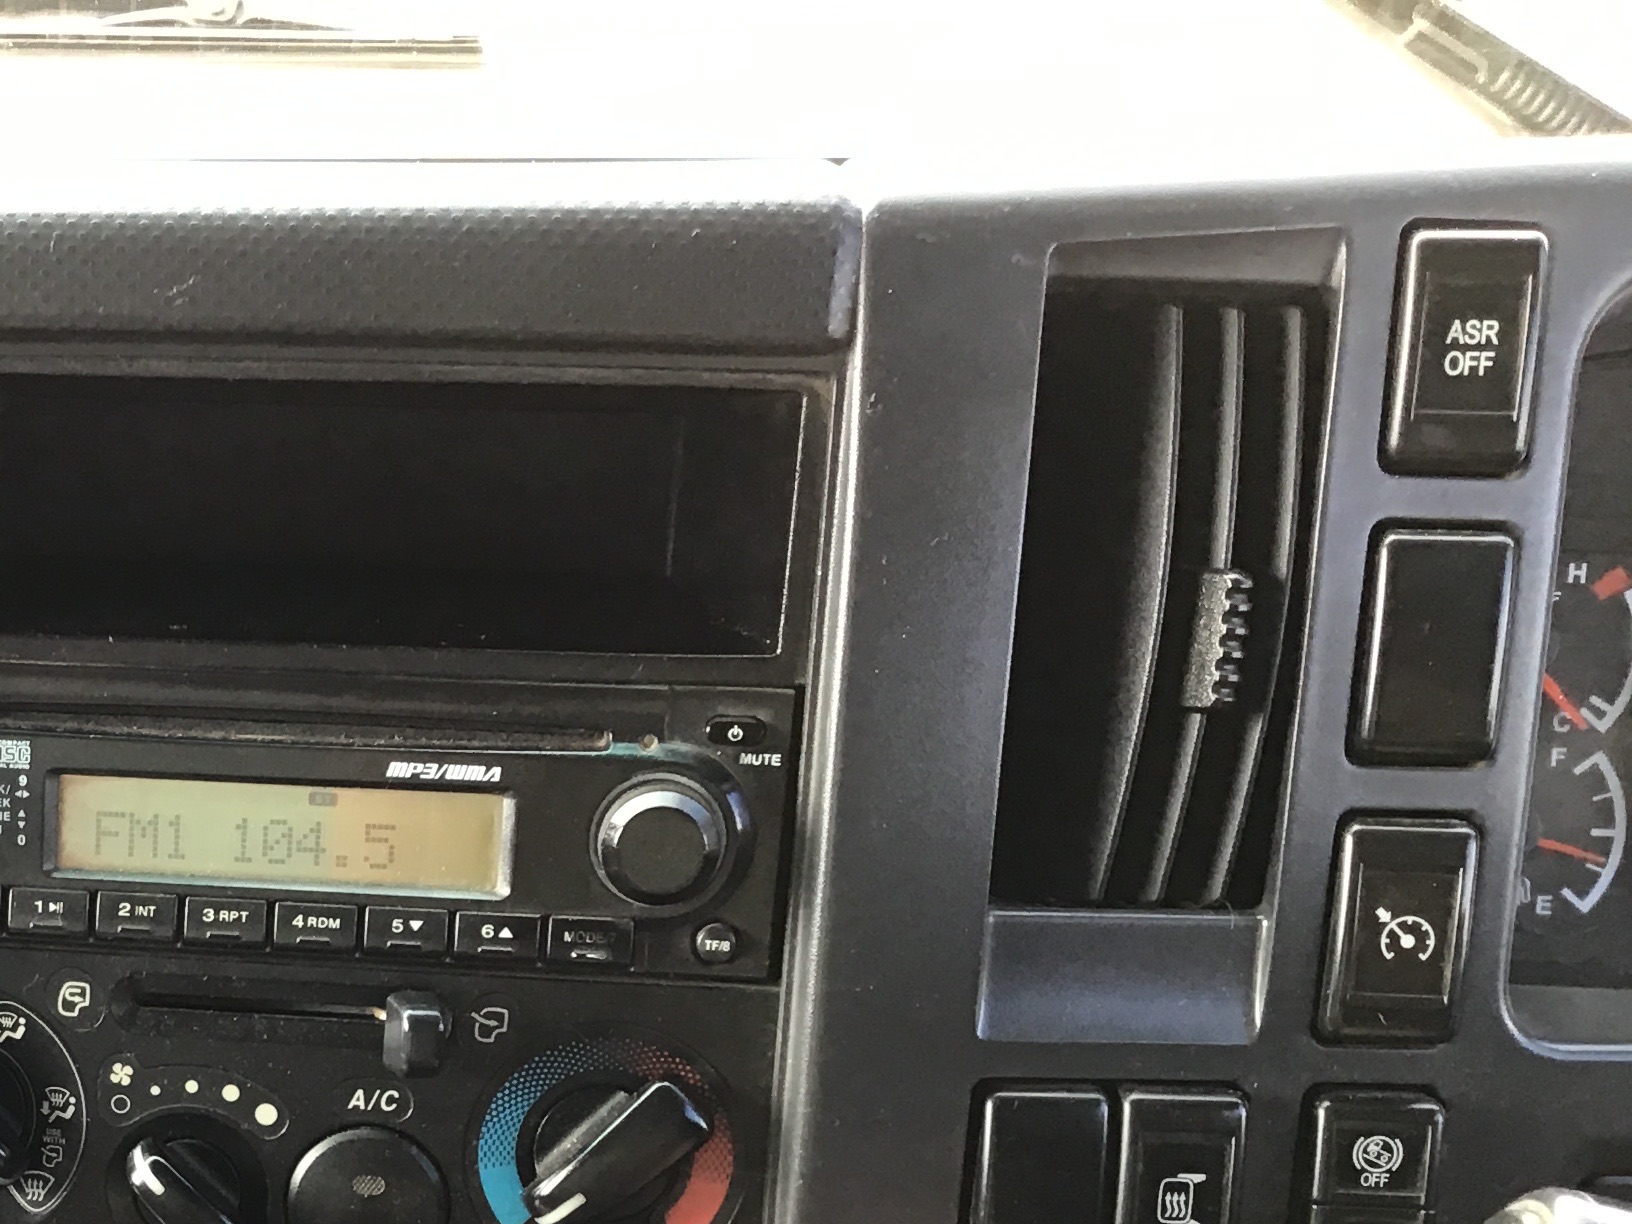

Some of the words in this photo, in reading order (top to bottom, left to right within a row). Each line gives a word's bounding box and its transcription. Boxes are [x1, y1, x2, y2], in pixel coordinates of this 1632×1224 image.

[1445, 319, 1499, 346] ASR
[1443, 351, 1496, 377] OFF
[1567, 562, 1588, 584] H
[739, 753, 782, 766] MUTE
[1551, 747, 1567, 767] F
[95, 811, 185, 860] FM1
[235, 817, 396, 870] 104.5
[34, 900, 43, 914] 1
[118, 903, 131, 916] 2
[135, 905, 156, 918] INT
[1536, 895, 1553, 915] E
[202, 909, 215, 922] 3
[219, 910, 249, 923] RPT
[292, 914, 304, 929] 4
[307, 918, 341, 929] RDM
[392, 919, 404, 933] 5
[481, 925, 494, 939] 6
[348, 1089, 400, 1110] A/C
[1360, 1173, 1390, 1187] OFF
